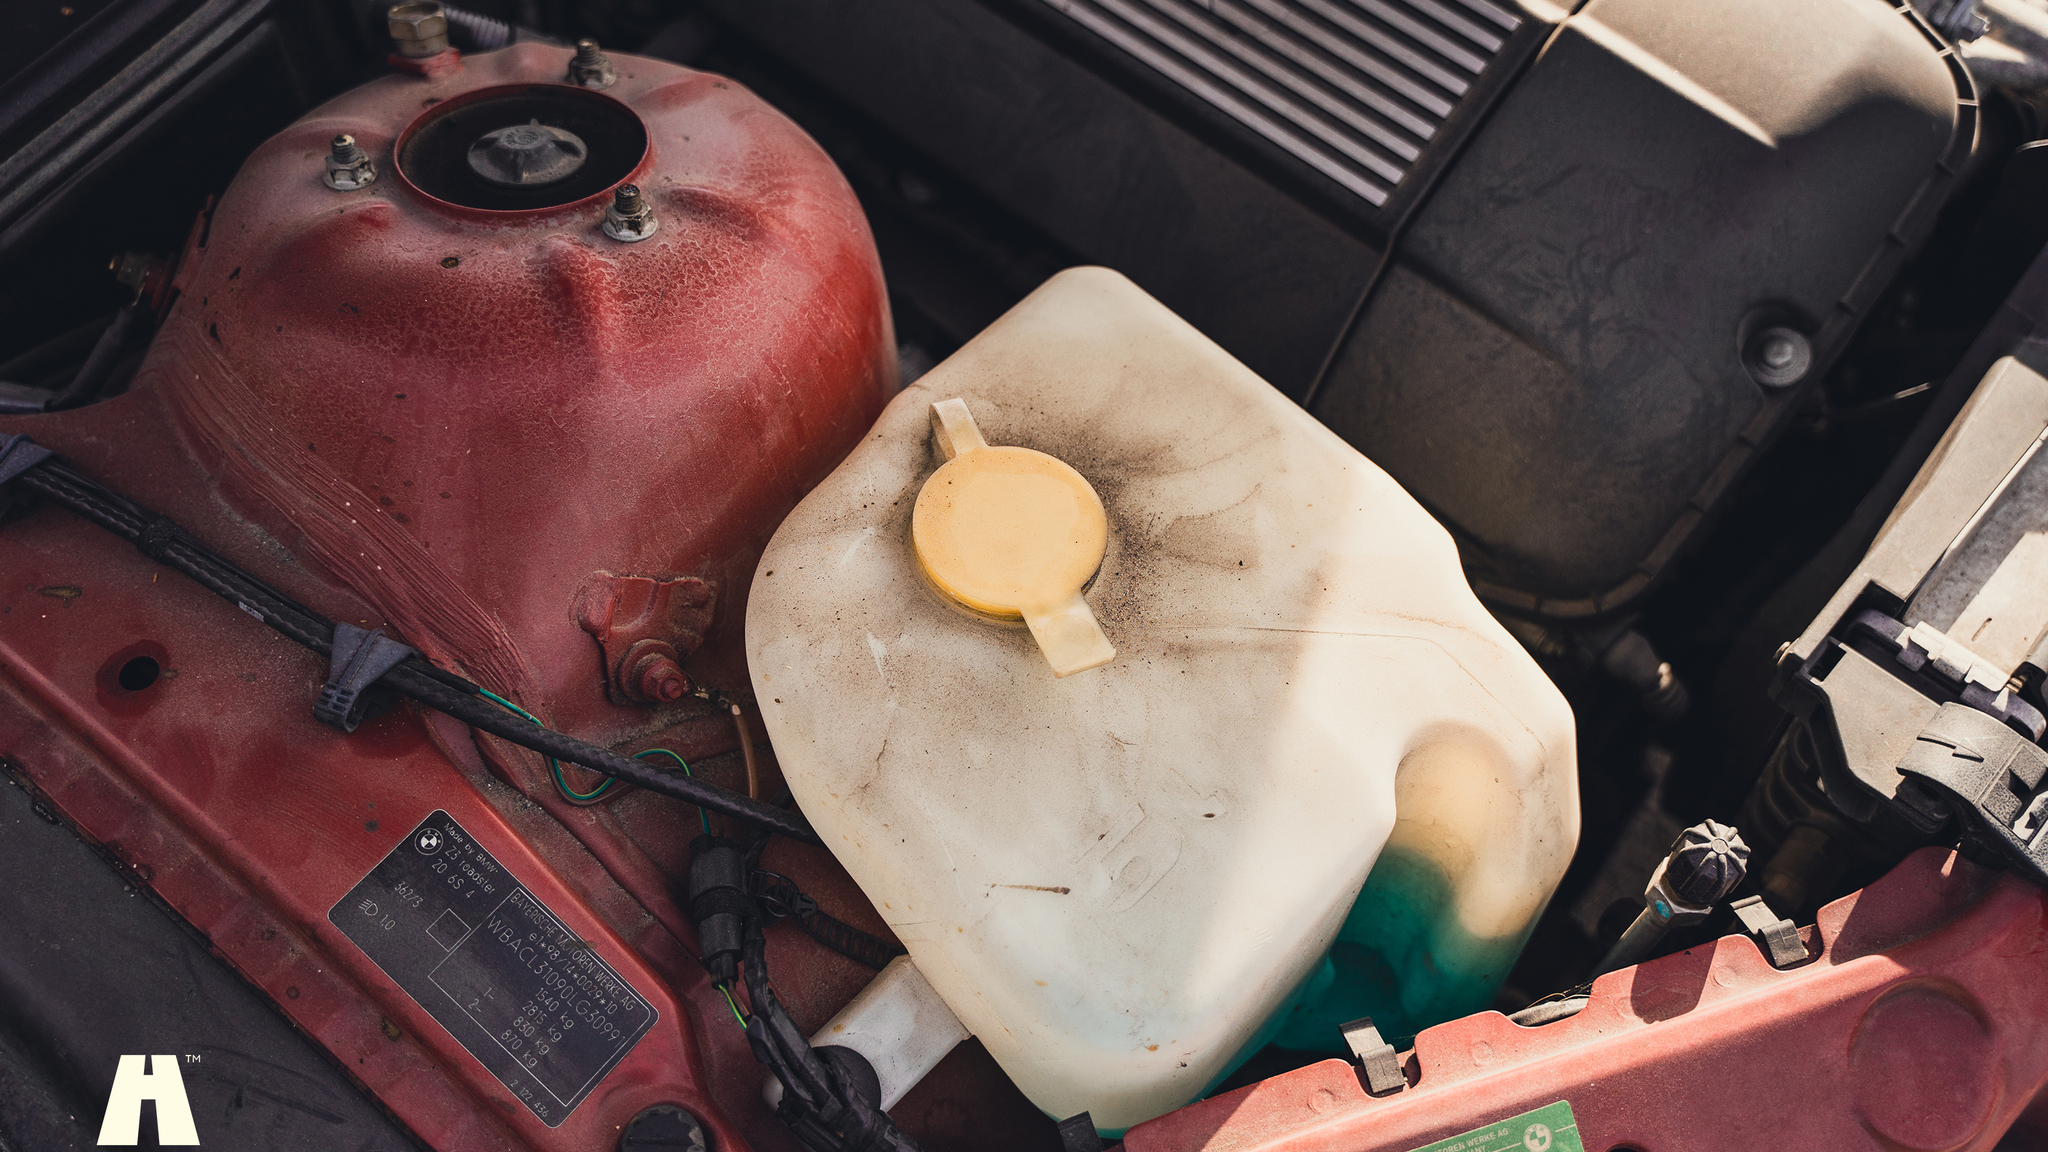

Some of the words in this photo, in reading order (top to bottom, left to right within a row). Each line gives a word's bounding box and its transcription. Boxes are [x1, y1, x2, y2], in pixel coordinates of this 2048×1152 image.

[443, 822, 464, 843] Made
[464, 843, 475, 855] by
[431, 858, 447, 874] 20
[447, 874, 464, 890] 6S
[465, 889, 475, 899] 4
[444, 845, 461, 860] Z3
[458, 860, 495, 894] roadster
[394, 881, 423, 908] 362/3
[379, 914, 396, 931] 1.0
[510, 893, 558, 937] BAYERISCHE
[595, 971, 622, 999] WERKE
[620, 996, 636, 1011] AG
[487, 916, 625, 1048] WBACL31090LG30991
[522, 1000, 548, 1025] 2815
[546, 1023, 563, 1043] kg
[535, 987, 560, 1012] 1540
[559, 1010, 575, 1030] kg
[501, 1028, 523, 1050] 870
[522, 1049, 538, 1069] kg
[513, 1016, 535, 1038] 830
[534, 1036, 550, 1056] kg
[509, 1078, 519, 1089] 2
[520, 1087, 533, 1101] 122
[533, 1102, 549, 1117] 436
[1466, 1131, 1496, 1147] WERKE
[1497, 1128, 1509, 1138] AG
